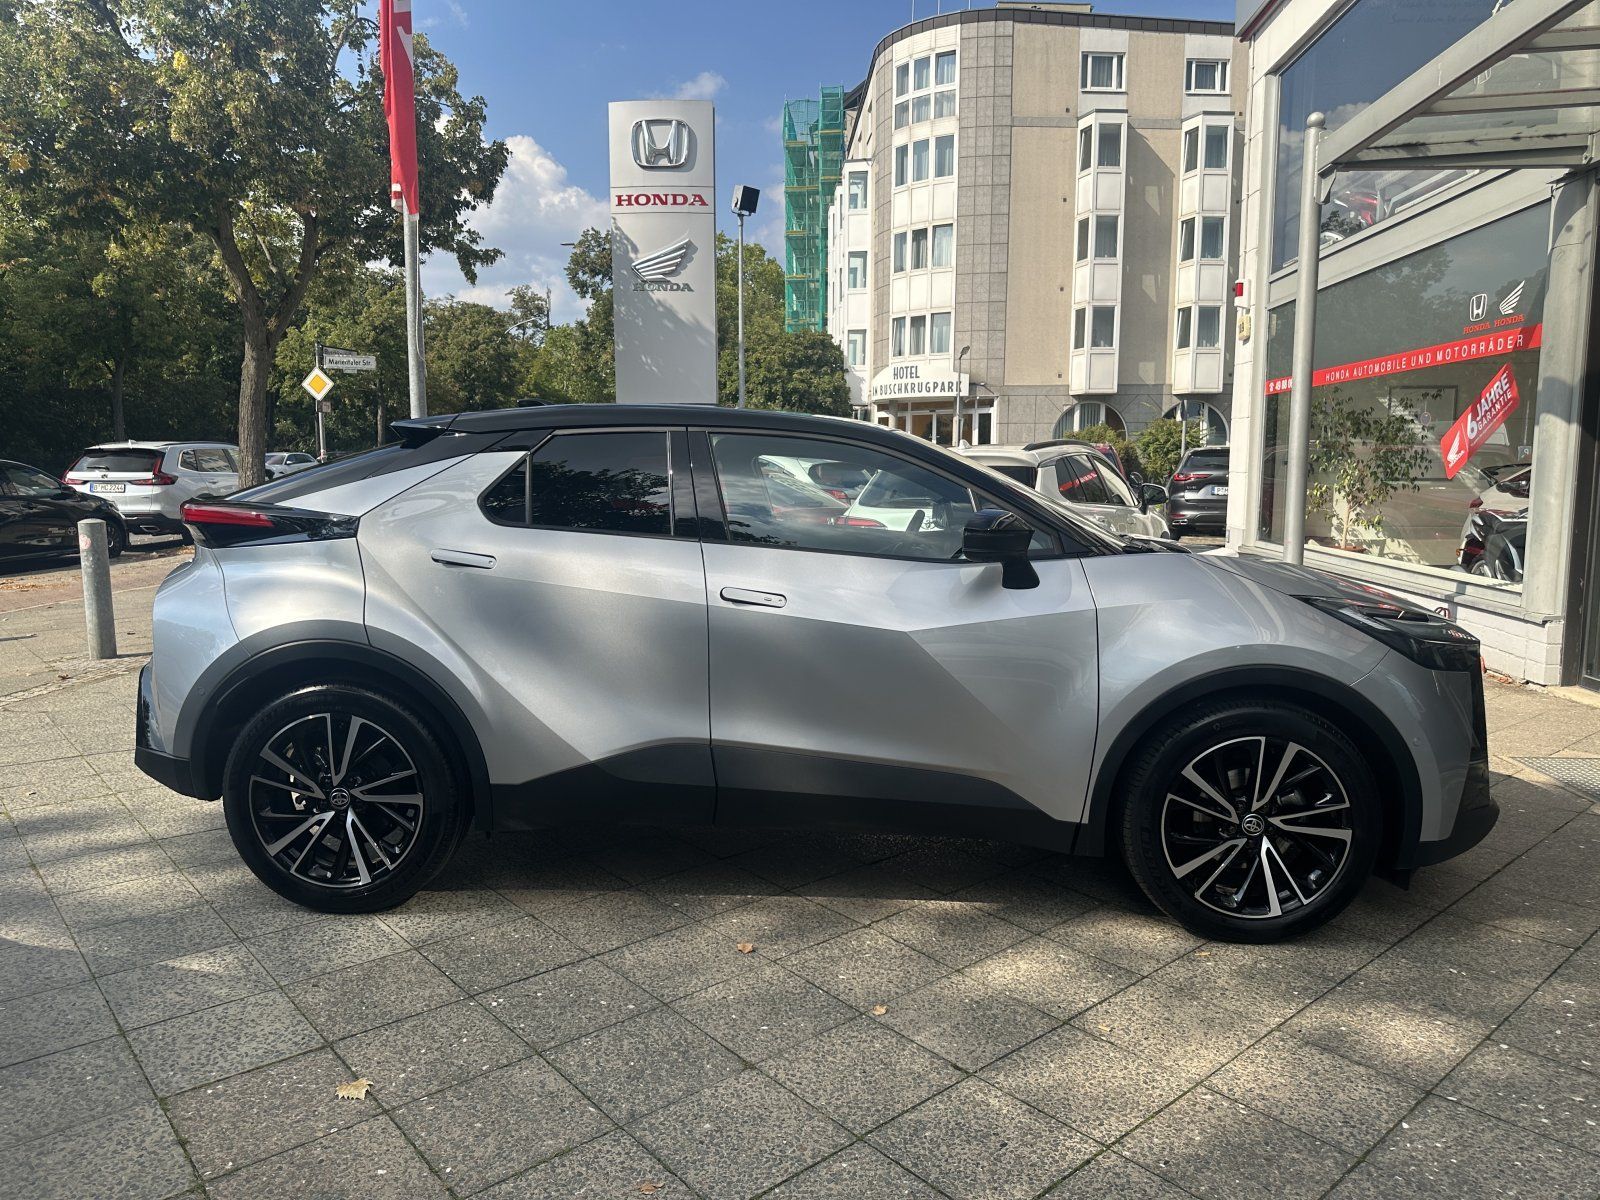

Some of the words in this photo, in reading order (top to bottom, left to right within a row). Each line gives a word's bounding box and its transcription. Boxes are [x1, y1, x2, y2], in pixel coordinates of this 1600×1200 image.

[616, 194, 708, 206] HONDA
[633, 282, 694, 292] HONDA
[1463, 322, 1490, 334] HONDA
[1494, 314, 1524, 327] HONDA
[1325, 370, 1350, 382] HONDA
[1353, 357, 1407, 377] AUTOMOBILE
[1411, 353, 1432, 367] UND
[1436, 334, 1524, 362] MOTORRÄDER
[893, 365, 920, 380] HOTEL
[880, 381, 962, 396] BUSCHKRUGPARK
[1475, 372, 1510, 422] JAHRE
[1478, 388, 1513, 431] GARANTIE
[1466, 412, 1478, 440] 6
